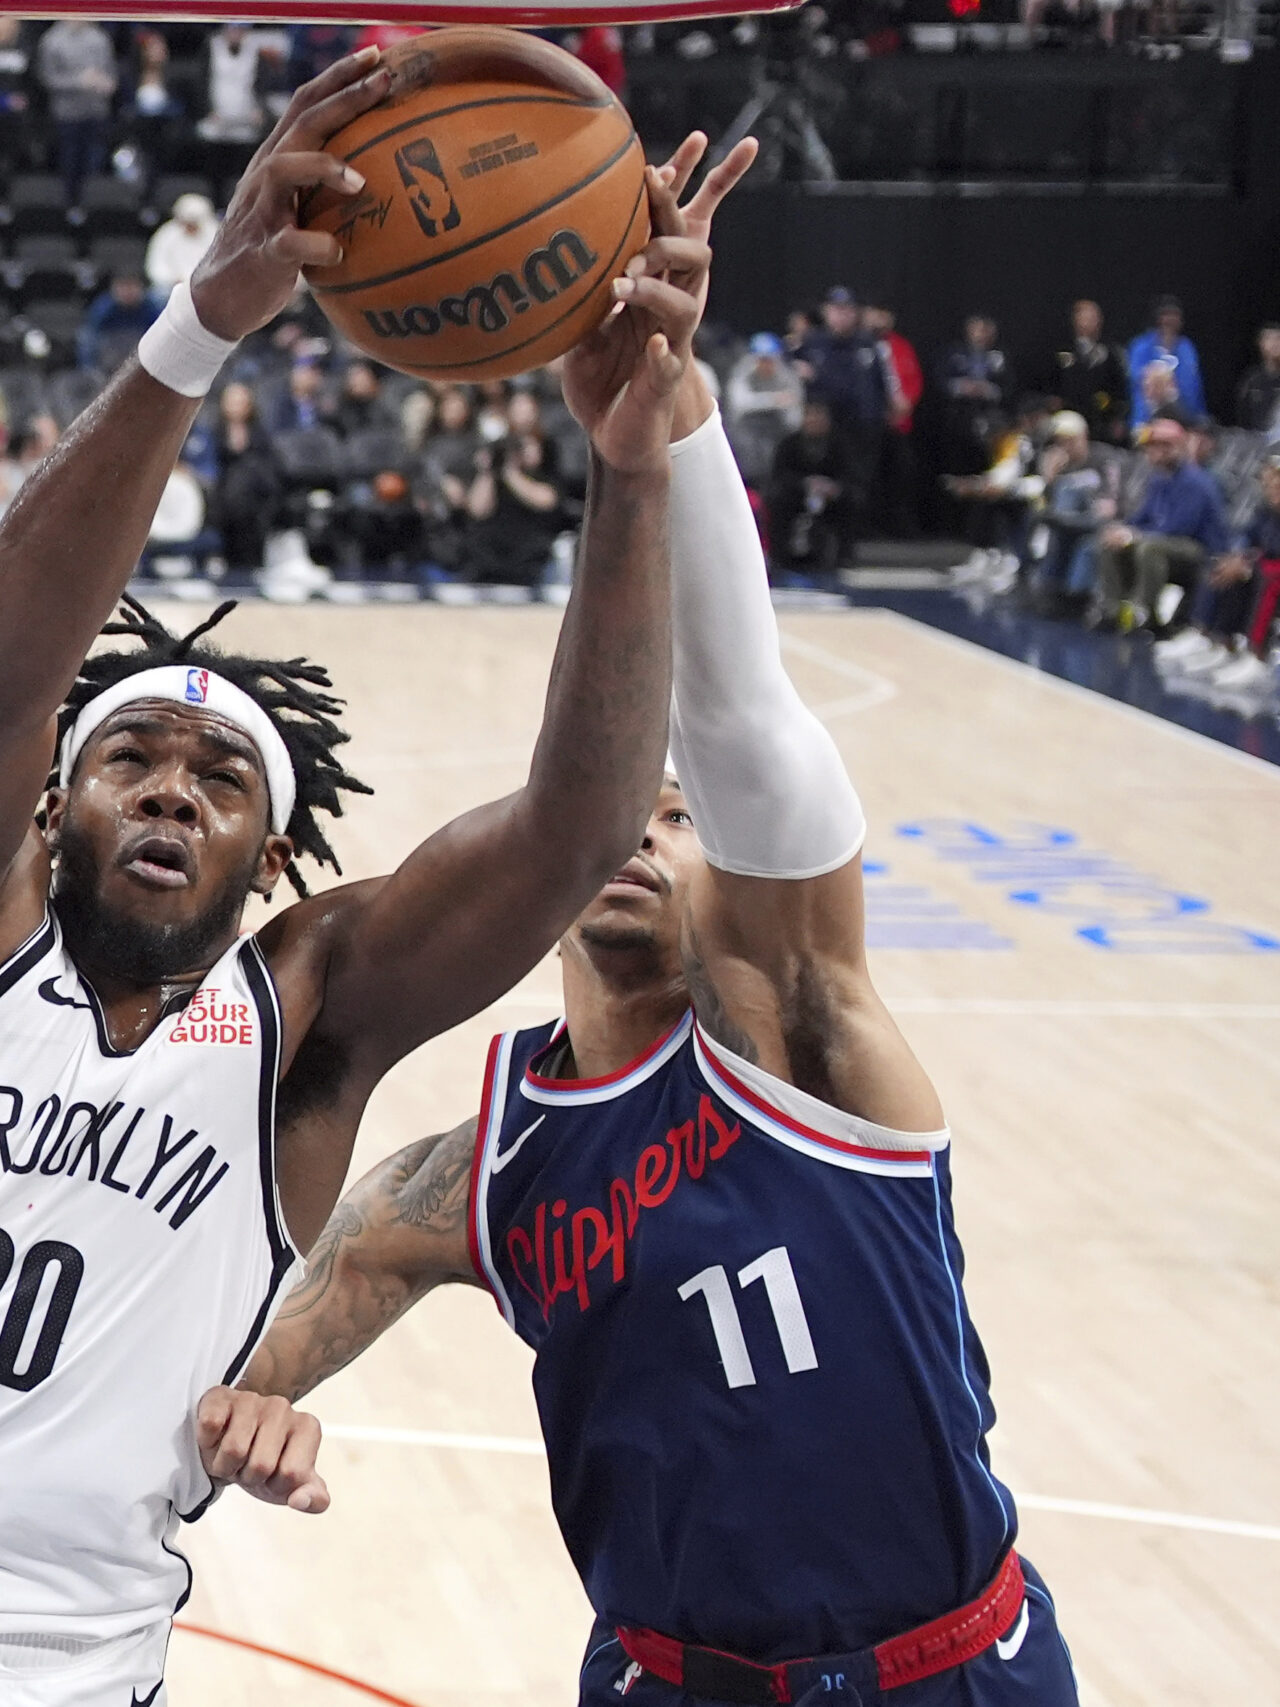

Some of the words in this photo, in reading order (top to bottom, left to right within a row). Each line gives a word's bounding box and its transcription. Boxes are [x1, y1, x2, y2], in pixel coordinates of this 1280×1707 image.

[362, 229, 598, 337] Wilson
[169, 1024, 252, 1044] GUIDE
[192, 989, 221, 1004] ET
[508, 1095, 740, 1322] Clippers
[677, 1246, 818, 1389] 11
